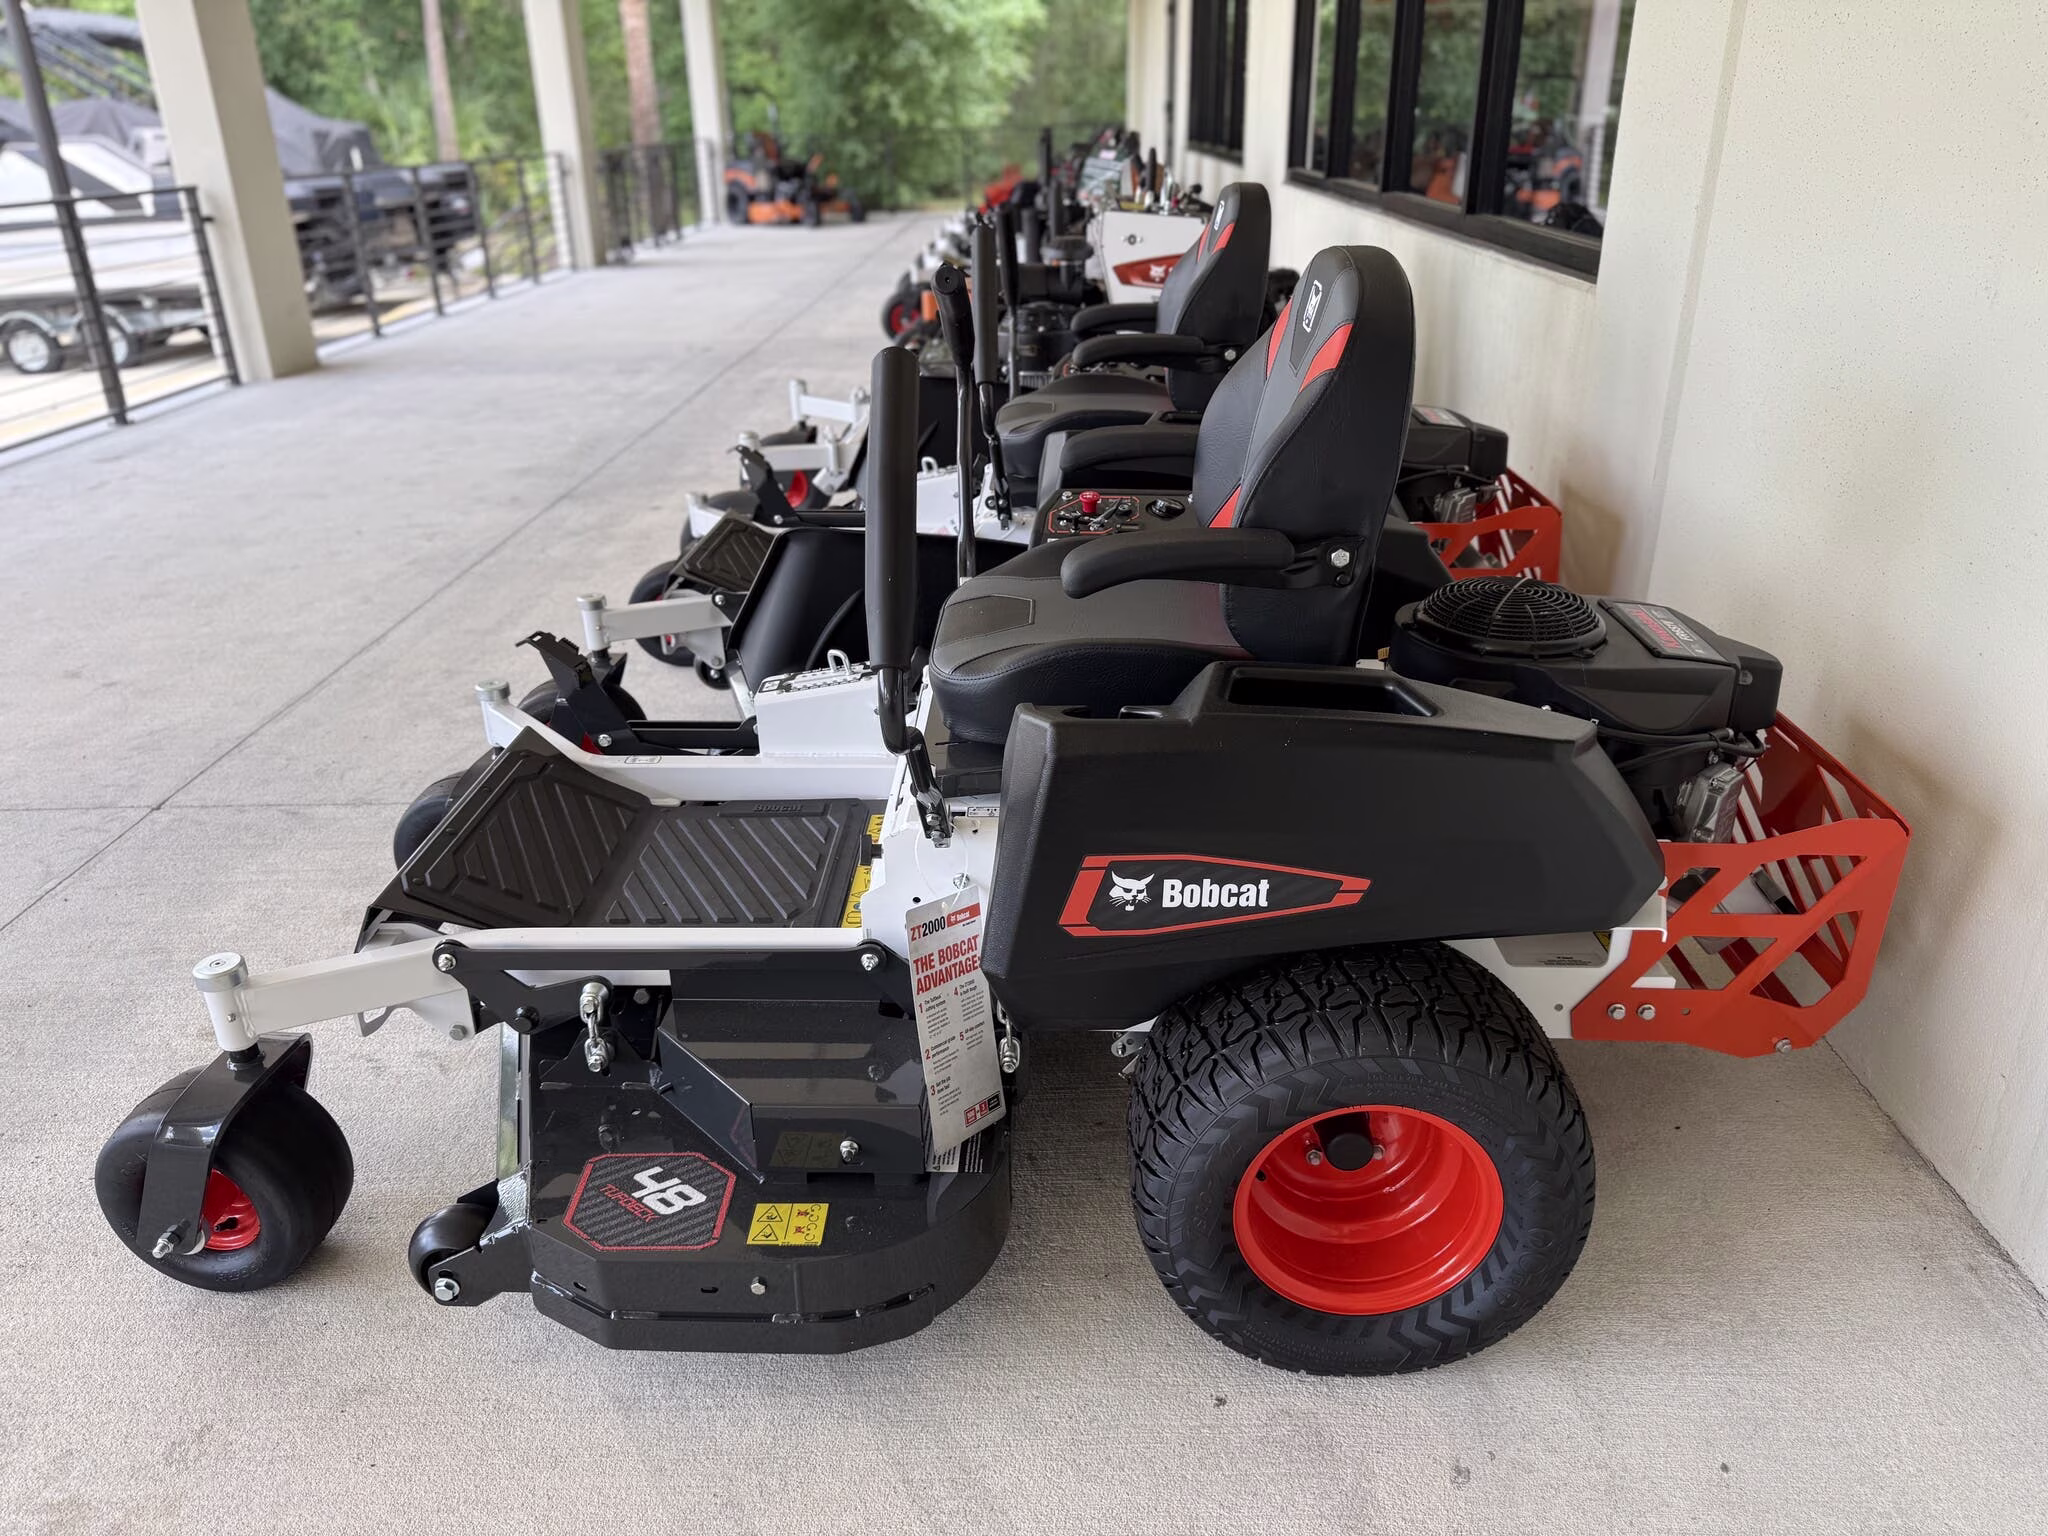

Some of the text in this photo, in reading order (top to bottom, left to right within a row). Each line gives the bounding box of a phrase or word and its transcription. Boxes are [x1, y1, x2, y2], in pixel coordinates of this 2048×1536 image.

[1162, 879, 1270, 908] Bobcat
[910, 916, 946, 941] ZT2000
[913, 934, 979, 975] THE BOBCAT
[953, 986, 959, 996] 4
[918, 1002, 924, 1014] 1
[959, 1031, 965, 1041] 5
[924, 1048, 931, 1060] 2
[930, 1084, 936, 1096] 3
[631, 1166, 707, 1215] 48
